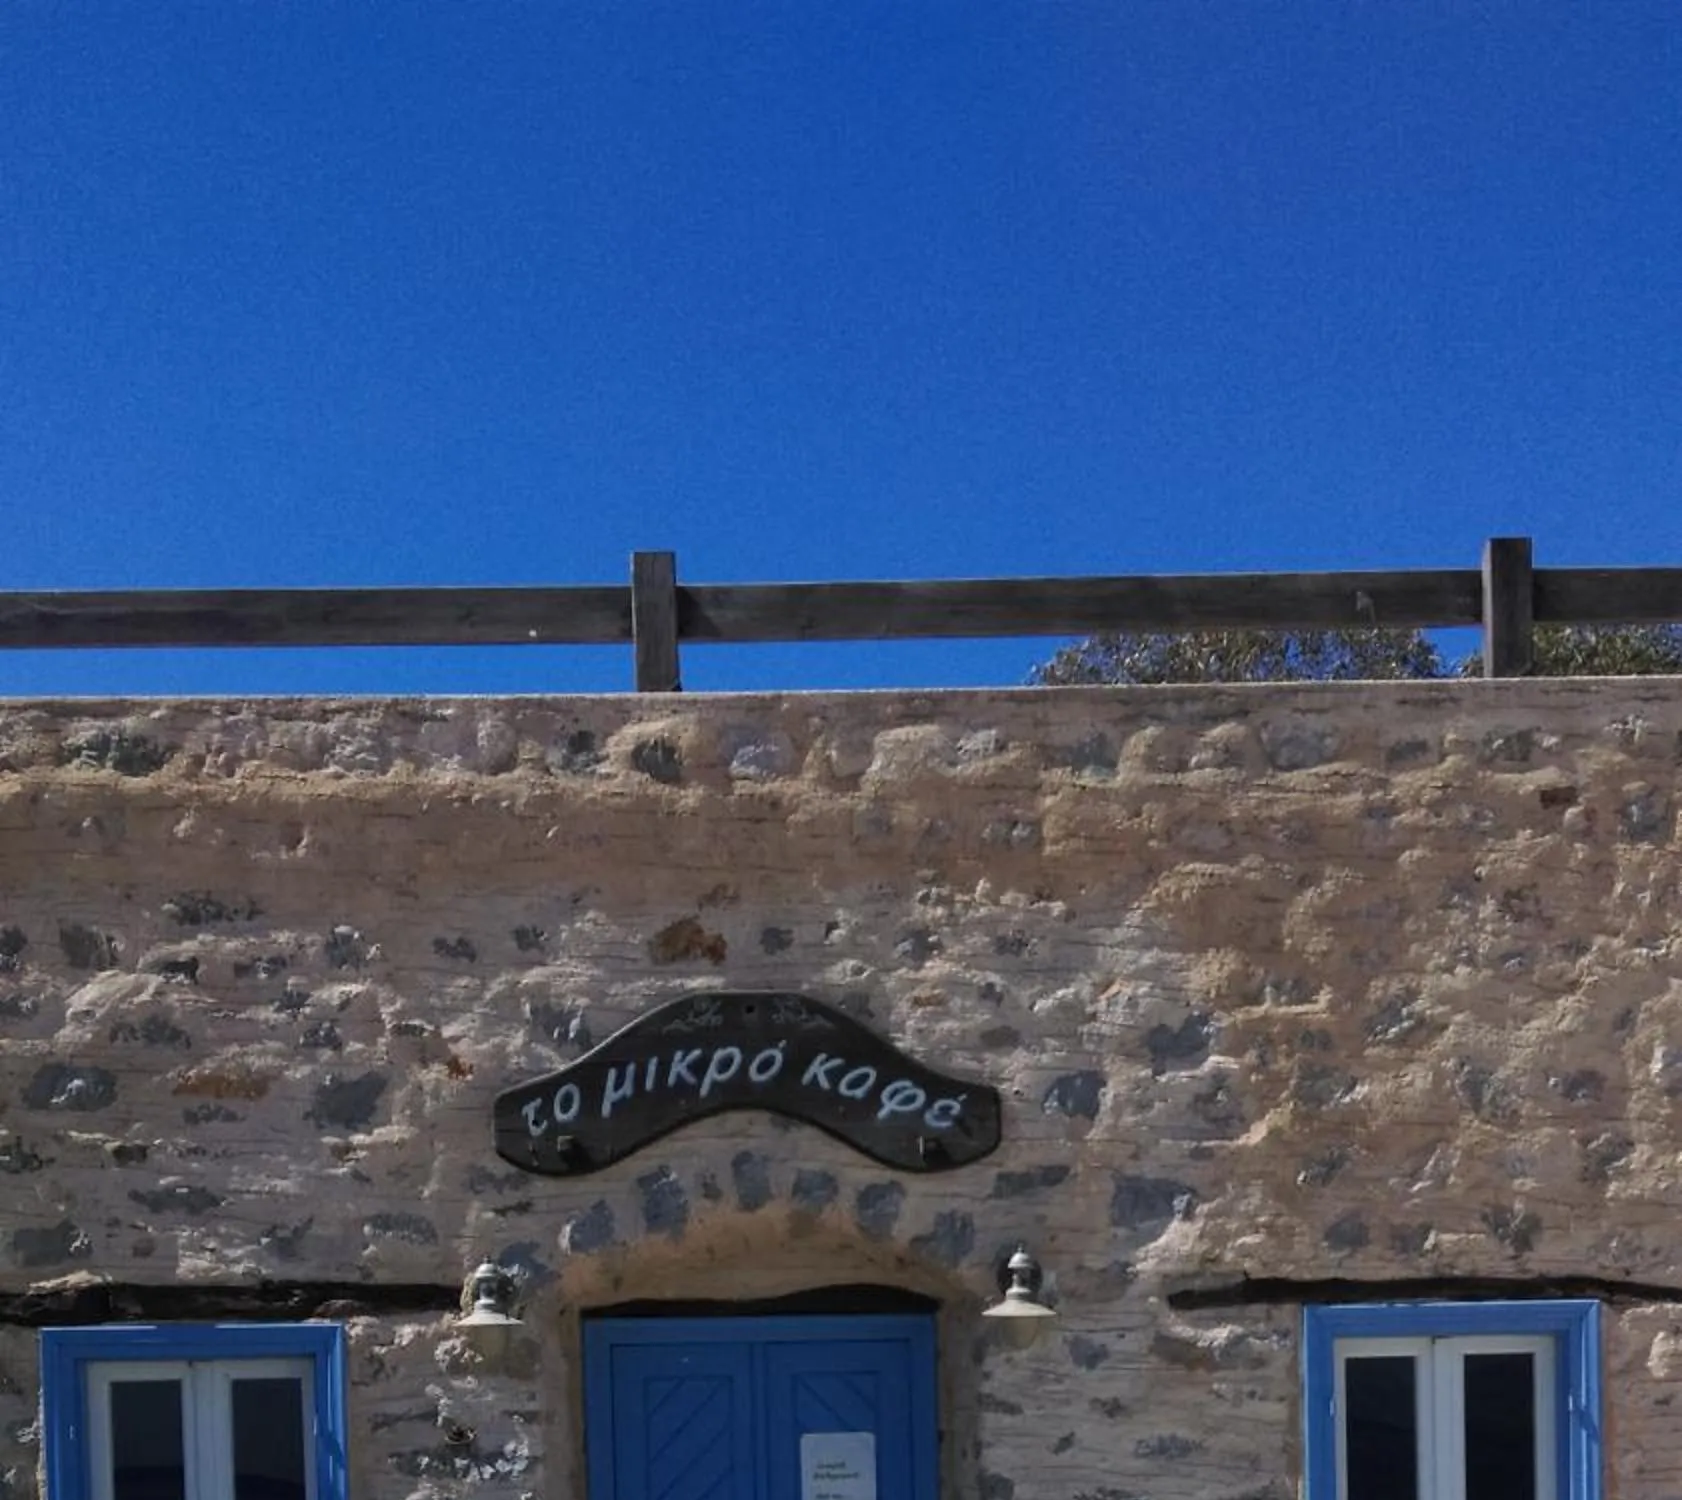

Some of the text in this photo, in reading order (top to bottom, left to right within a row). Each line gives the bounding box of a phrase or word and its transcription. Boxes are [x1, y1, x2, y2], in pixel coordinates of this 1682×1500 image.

[521, 1040, 967, 1137] το μικρό καφέ
